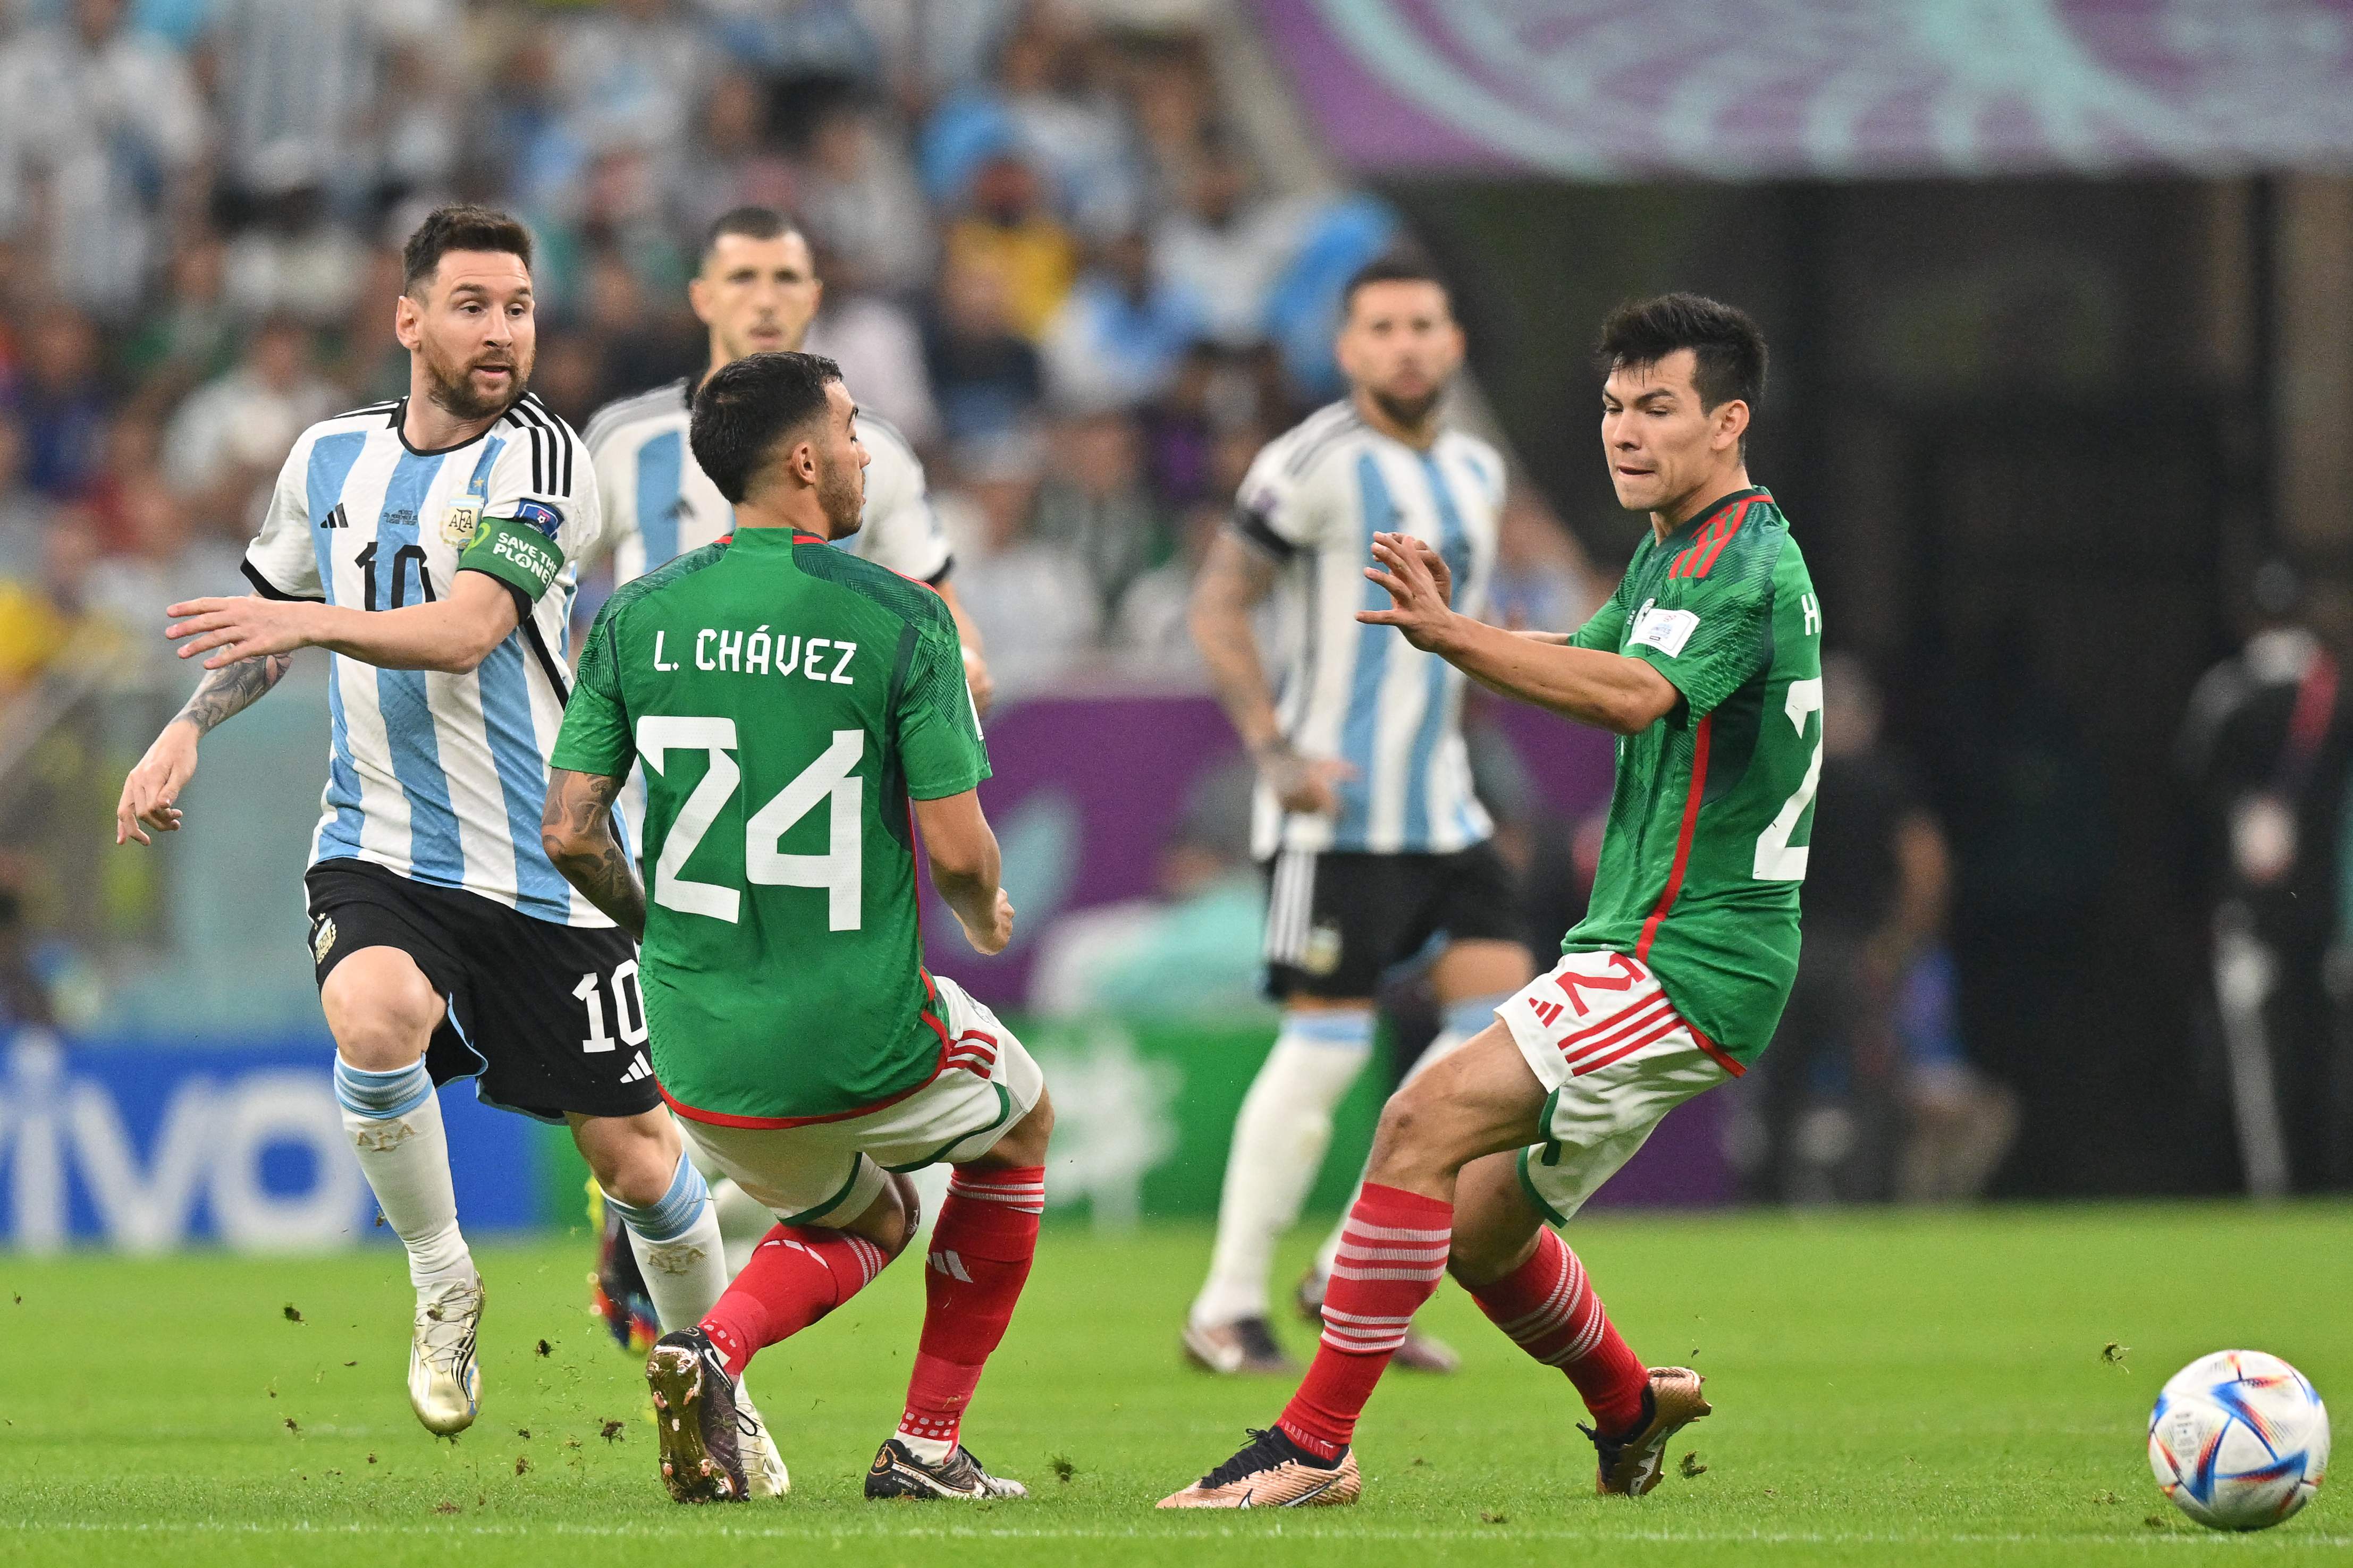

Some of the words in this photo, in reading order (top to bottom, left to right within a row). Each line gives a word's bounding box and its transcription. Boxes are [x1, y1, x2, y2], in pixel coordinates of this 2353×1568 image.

[448, 508, 473, 533] AFA
[355, 541, 436, 612] 10
[492, 543, 553, 589] PLANET
[497, 532, 538, 558] SAVE
[540, 551, 558, 577] THE
[653, 630, 680, 671] L.
[695, 625, 857, 685] CHÁVEZ
[636, 715, 864, 931] 24
[572, 959, 648, 1053] 10
[1555, 952, 1647, 1018] 2
[0, 1028, 367, 1249] ivo
